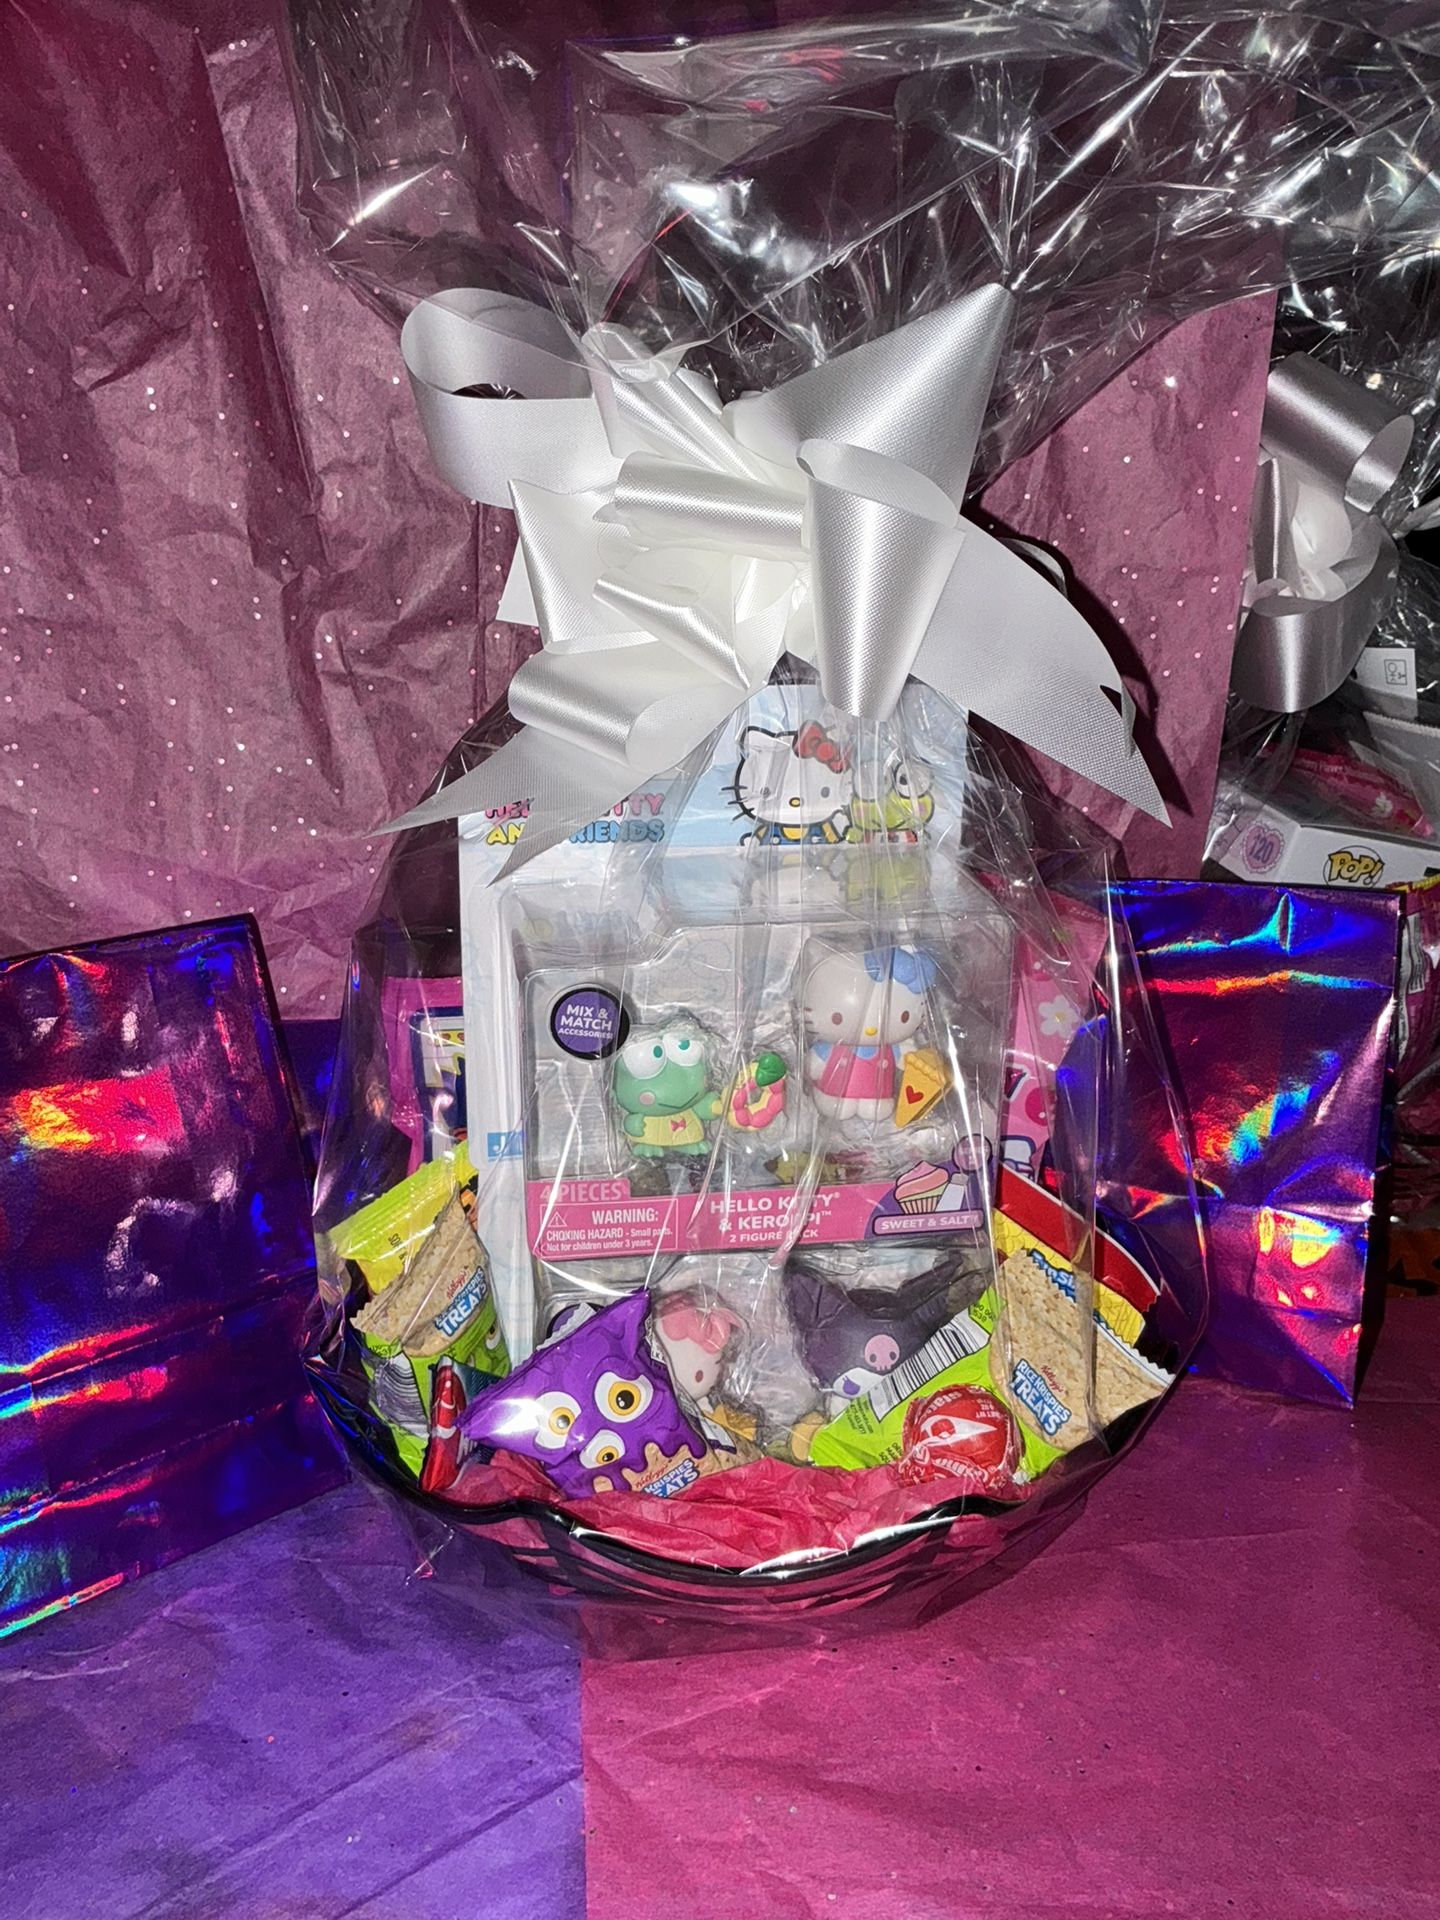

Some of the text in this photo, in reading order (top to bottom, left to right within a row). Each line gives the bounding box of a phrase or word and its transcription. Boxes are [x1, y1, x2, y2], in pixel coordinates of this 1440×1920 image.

[487, 819, 665, 845] AN RIENDS
[566, 1004, 609, 1019] MIX &
[560, 1015, 612, 1031] MATCH
[556, 1182, 622, 1202] PIECES
[710, 1197, 772, 1214] HELLO
[592, 1207, 659, 1225] WARNING:
[882, 1218, 924, 1231] SWEET
[927, 1218, 937, 1228] &
[588, 1227, 624, 1240] HAZARD
[631, 1226, 652, 1237] Small
[653, 1227, 673, 1239] pats.
[730, 1229, 818, 1243] 2 FIGURE PCK
[563, 1242, 571, 1251] for
[572, 1241, 601, 1251] children
[603, 1240, 623, 1249] under
[440, 1282, 486, 1336] TREATS
[1010, 1370, 1060, 1434] TREATS
[644, 1459, 693, 1493] KRISPIES
[653, 1468, 698, 1498] EATS
